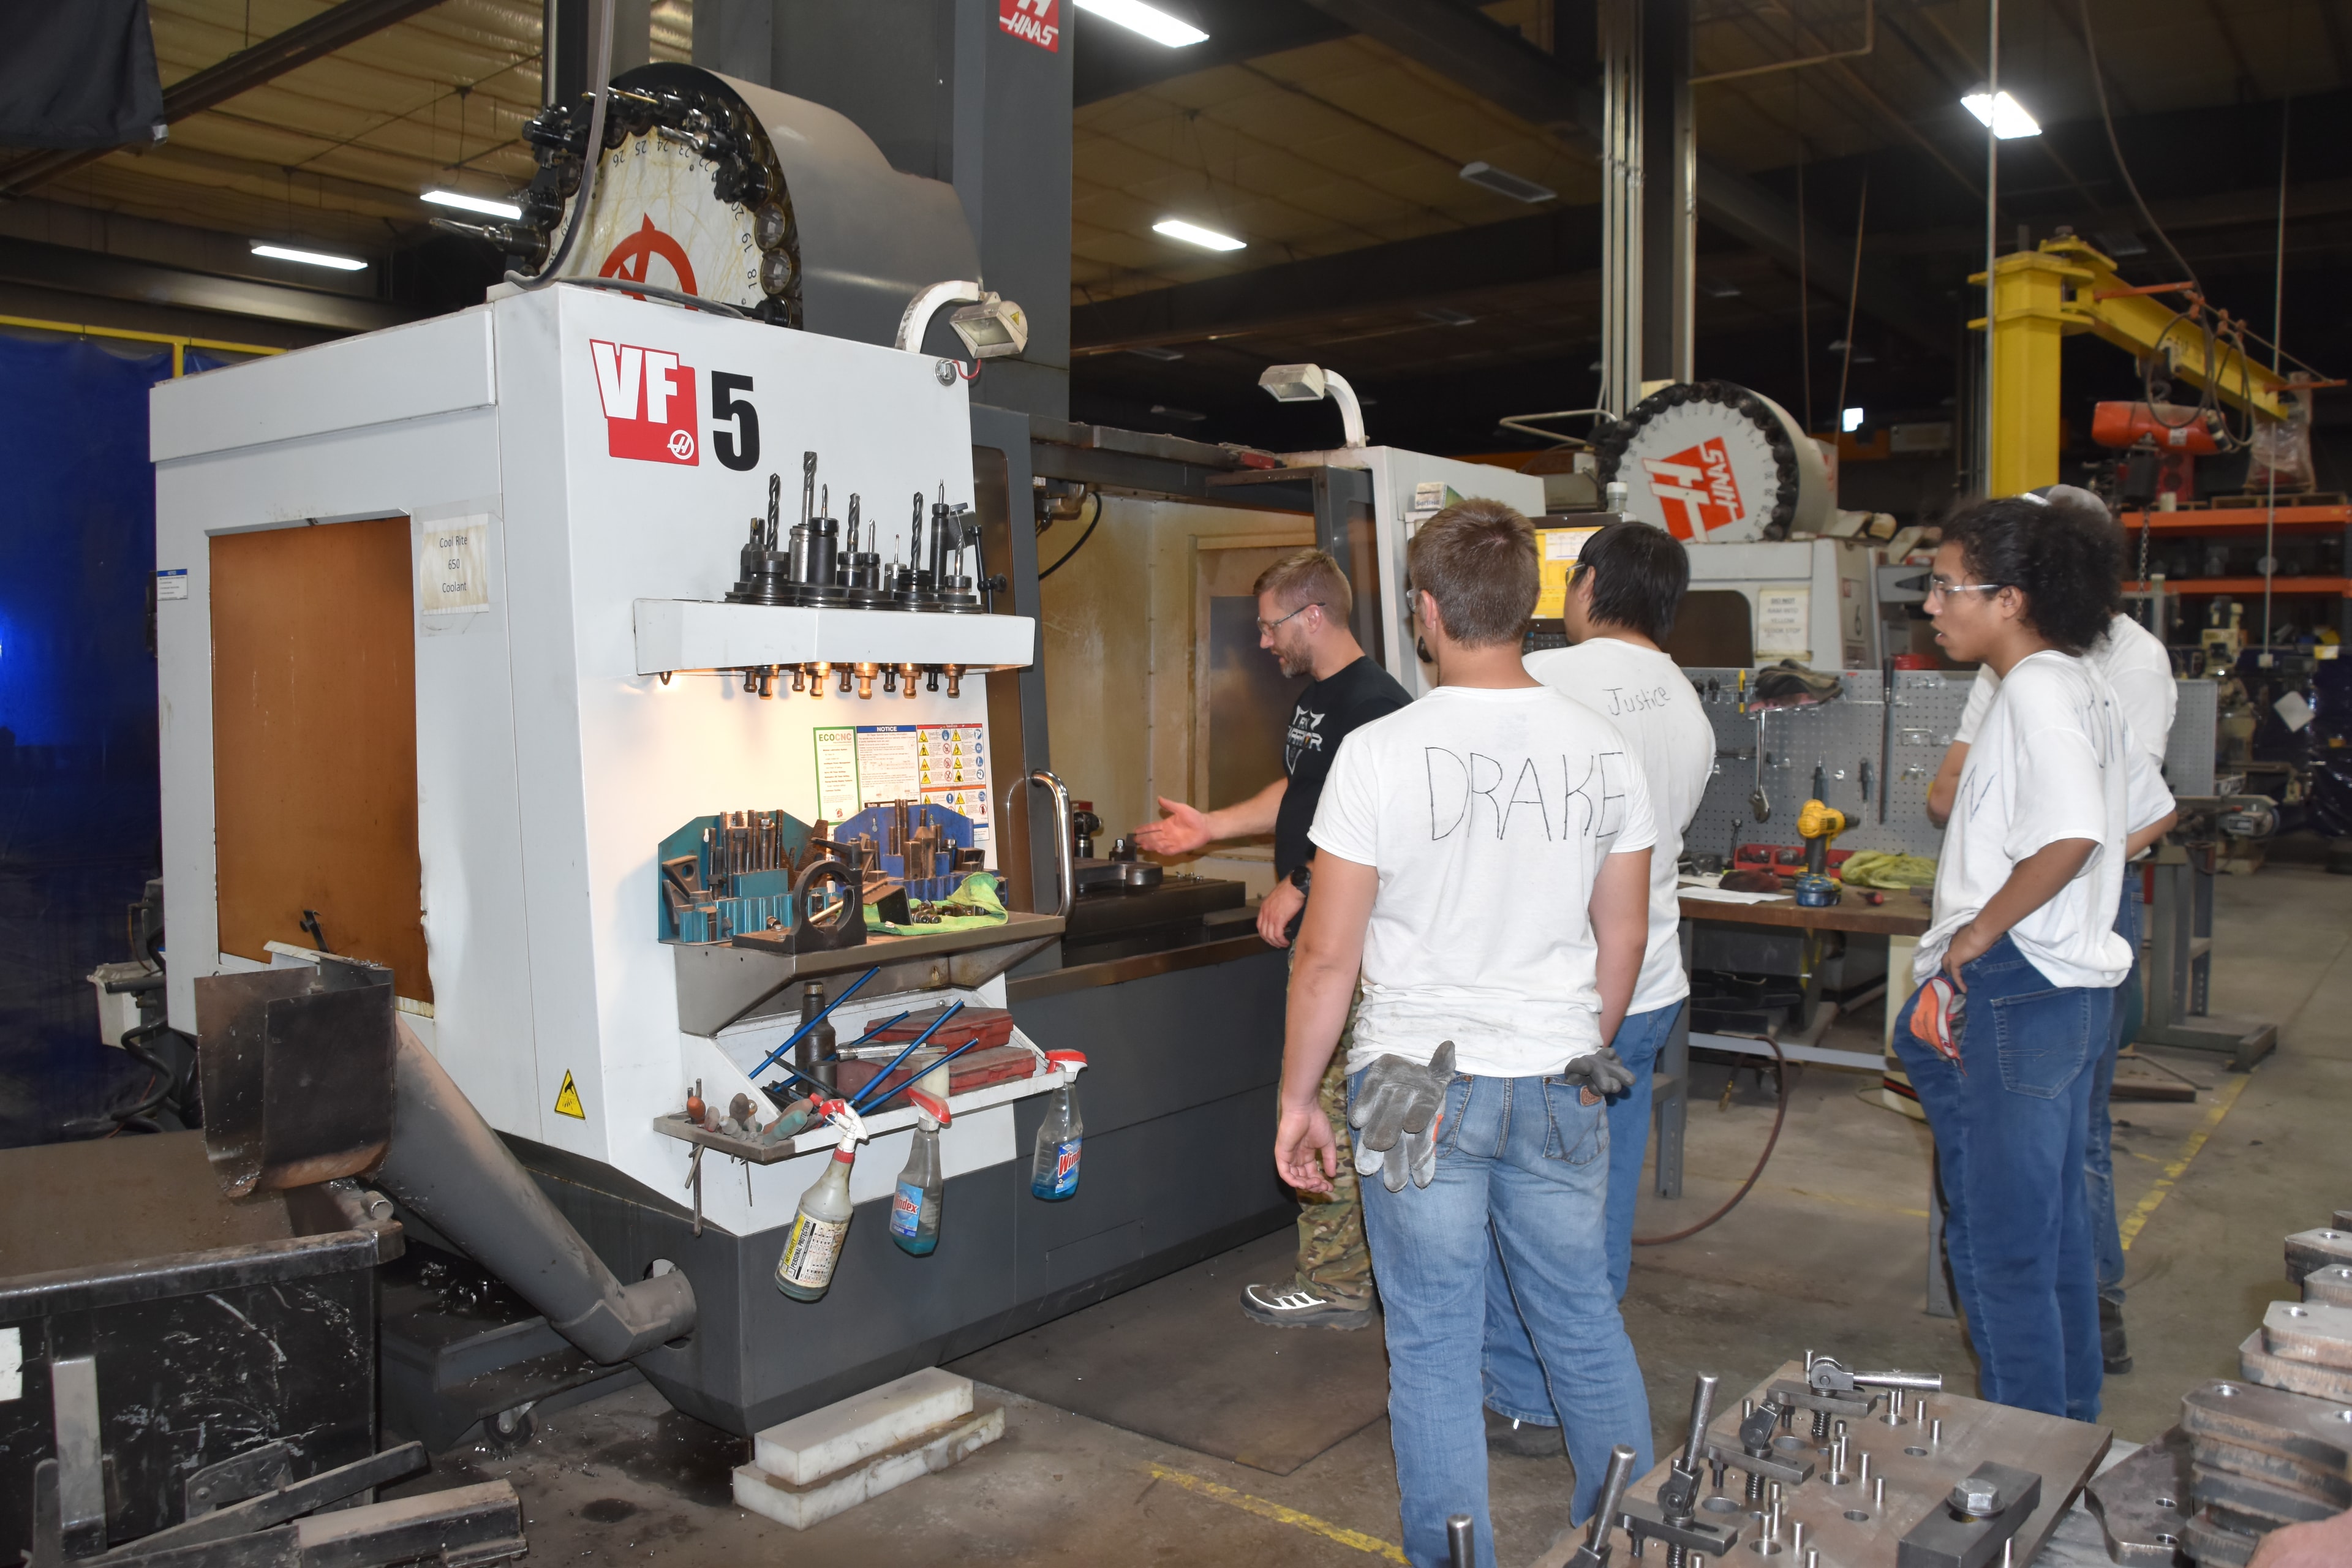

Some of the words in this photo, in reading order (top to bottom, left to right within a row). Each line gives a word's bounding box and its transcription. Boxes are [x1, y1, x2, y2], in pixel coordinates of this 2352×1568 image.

[1000, 12, 1058, 45] HAAS
[613, 149, 625, 168] 26
[635, 140, 647, 156] 25
[731, 200, 744, 221] 20
[742, 233, 753, 253] 19
[747, 268, 757, 290] 18
[590, 341, 678, 424] VF
[711, 369, 760, 472] 5
[1702, 445, 1740, 516] HAAS
[439, 536, 454, 548] Cool
[456, 535, 468, 546] Rite
[448, 558, 460, 570] 650
[442, 581, 467, 593] Coolant
[1602, 687, 1671, 715] Justice
[818, 733, 852, 742] ECOCNC
[1425, 747, 1625, 842] DRAKE
[1058, 1145, 1082, 1177] Wind
[785, 1238, 796, 1264] INSTABILITY
[791, 1246, 802, 1268] PERSONAL
[798, 1220, 811, 1247] PROTECTION
